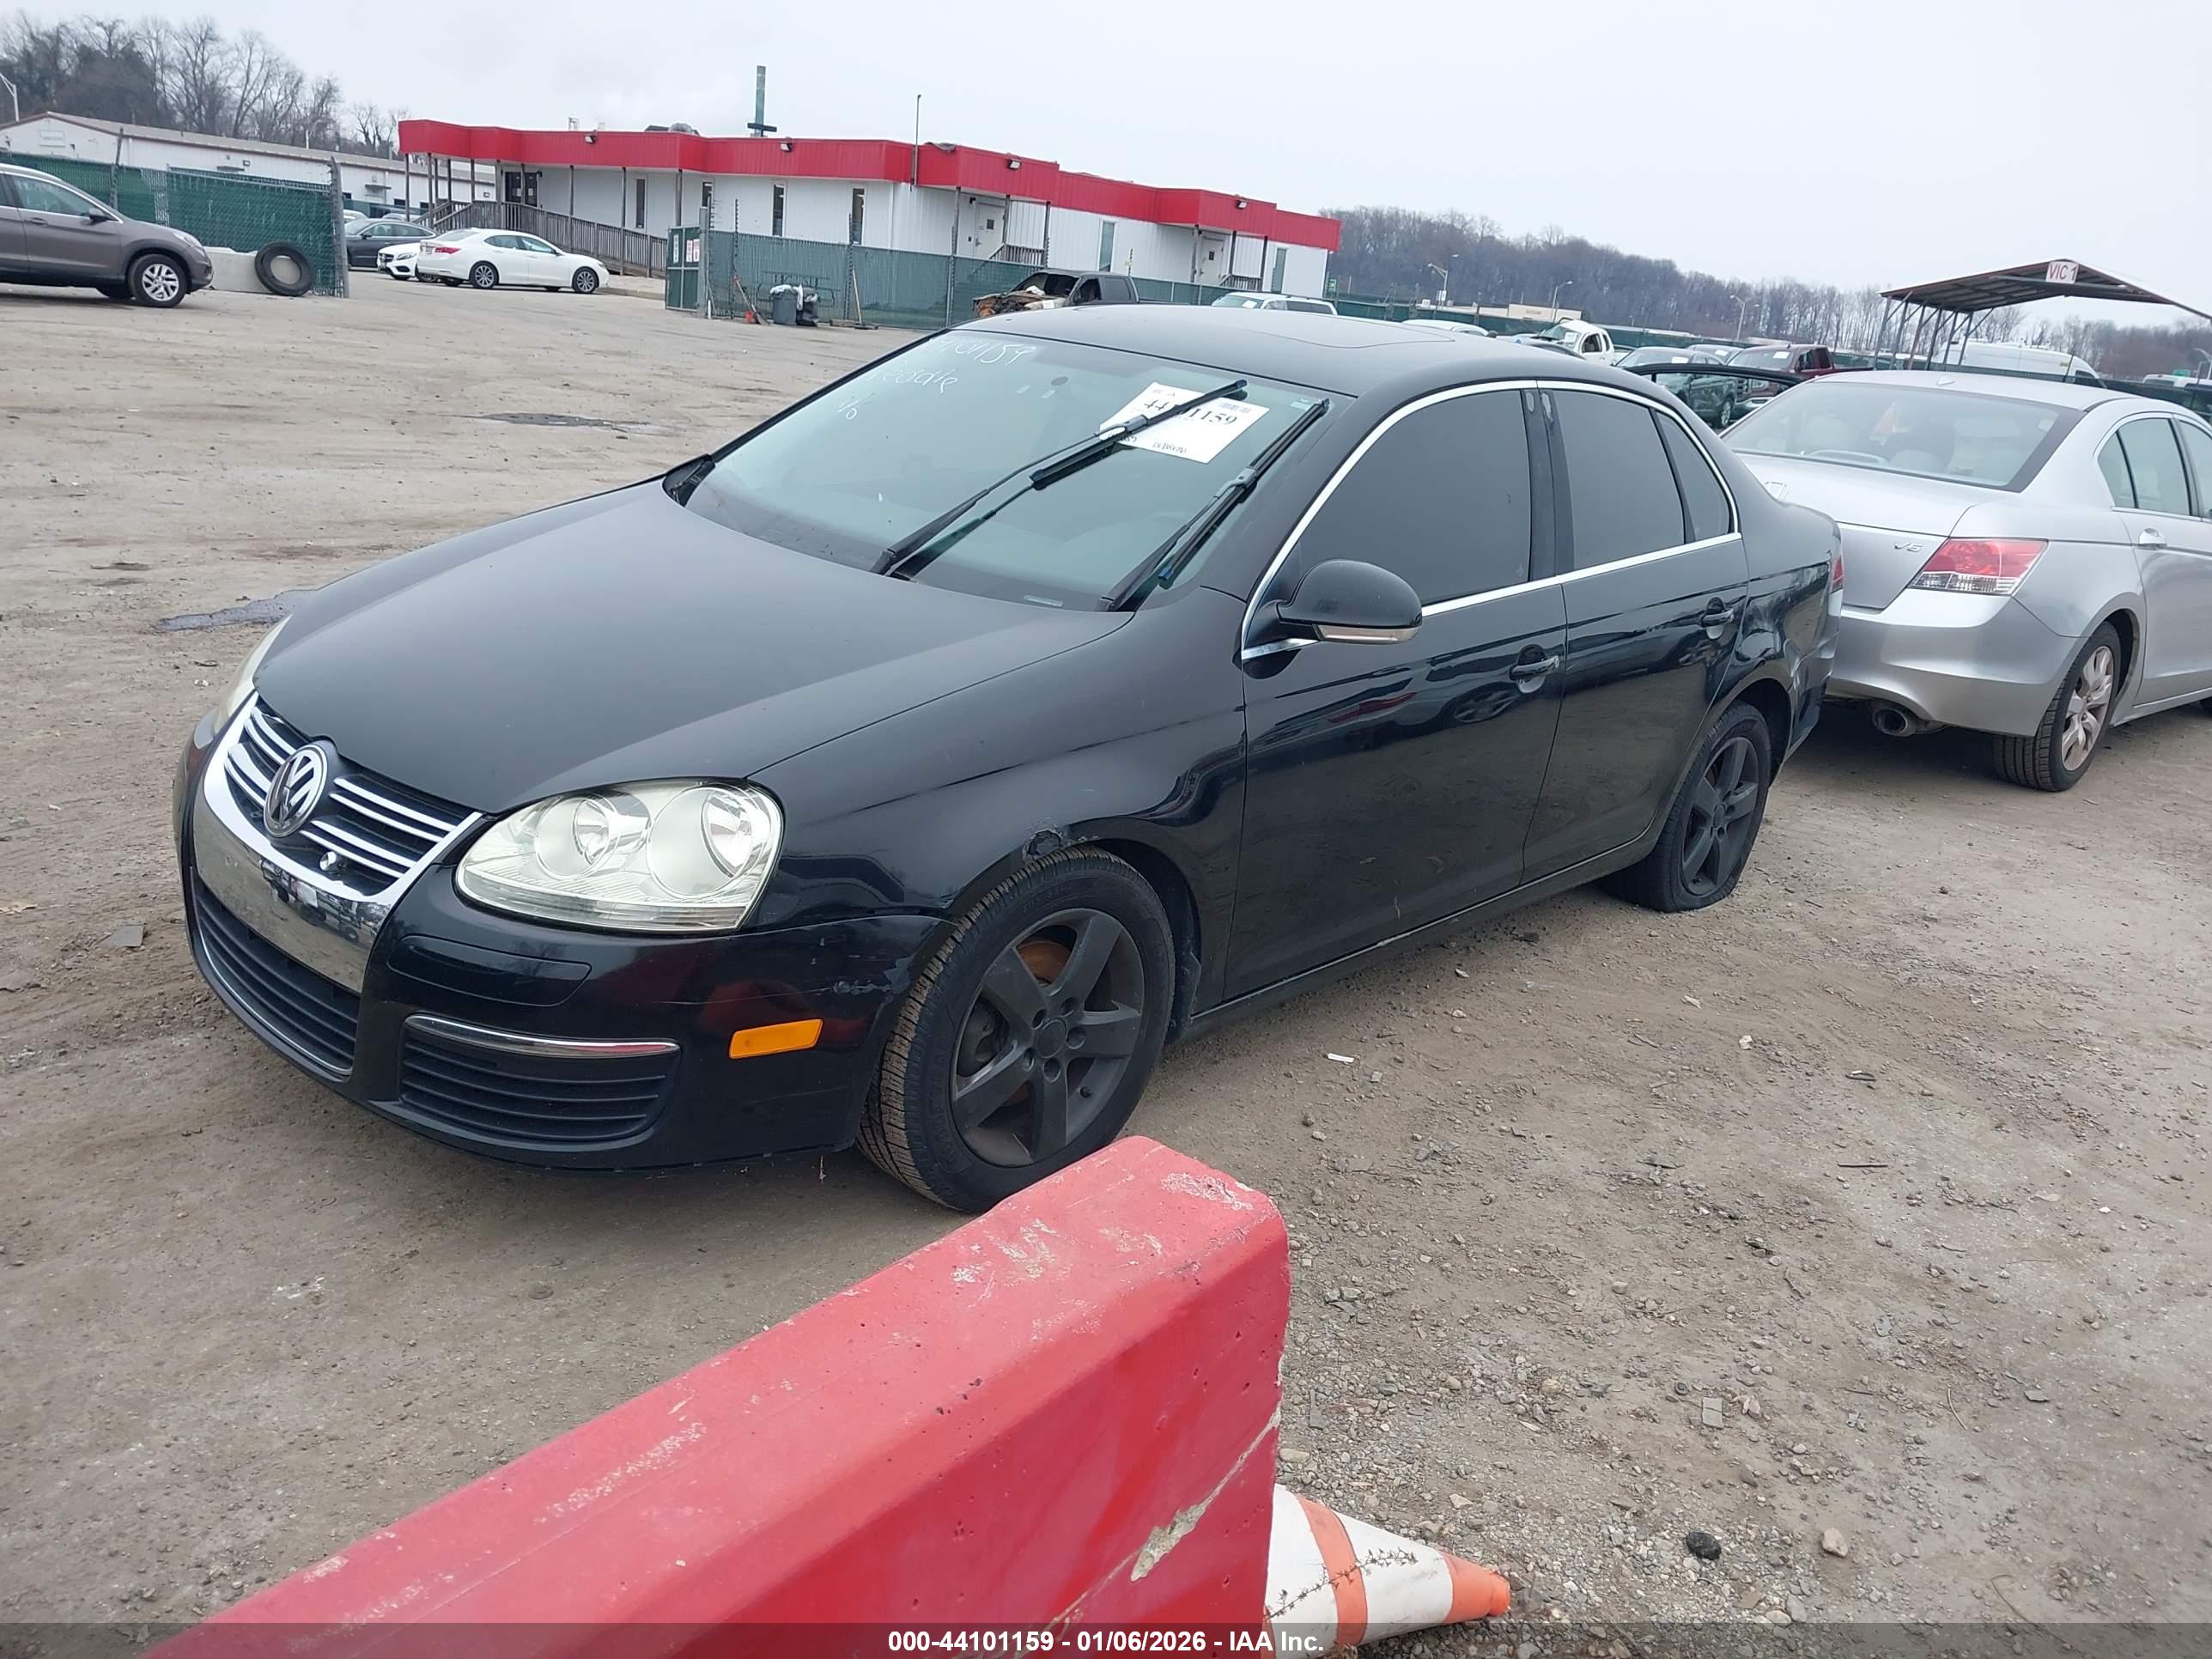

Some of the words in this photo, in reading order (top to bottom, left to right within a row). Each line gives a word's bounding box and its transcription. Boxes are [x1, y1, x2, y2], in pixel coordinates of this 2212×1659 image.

[2049, 264, 2068, 280] VIC
[2070, 266, 2077, 281] 1
[1144, 399, 1237, 425] 441159
[1893, 543, 1923, 553] V6
